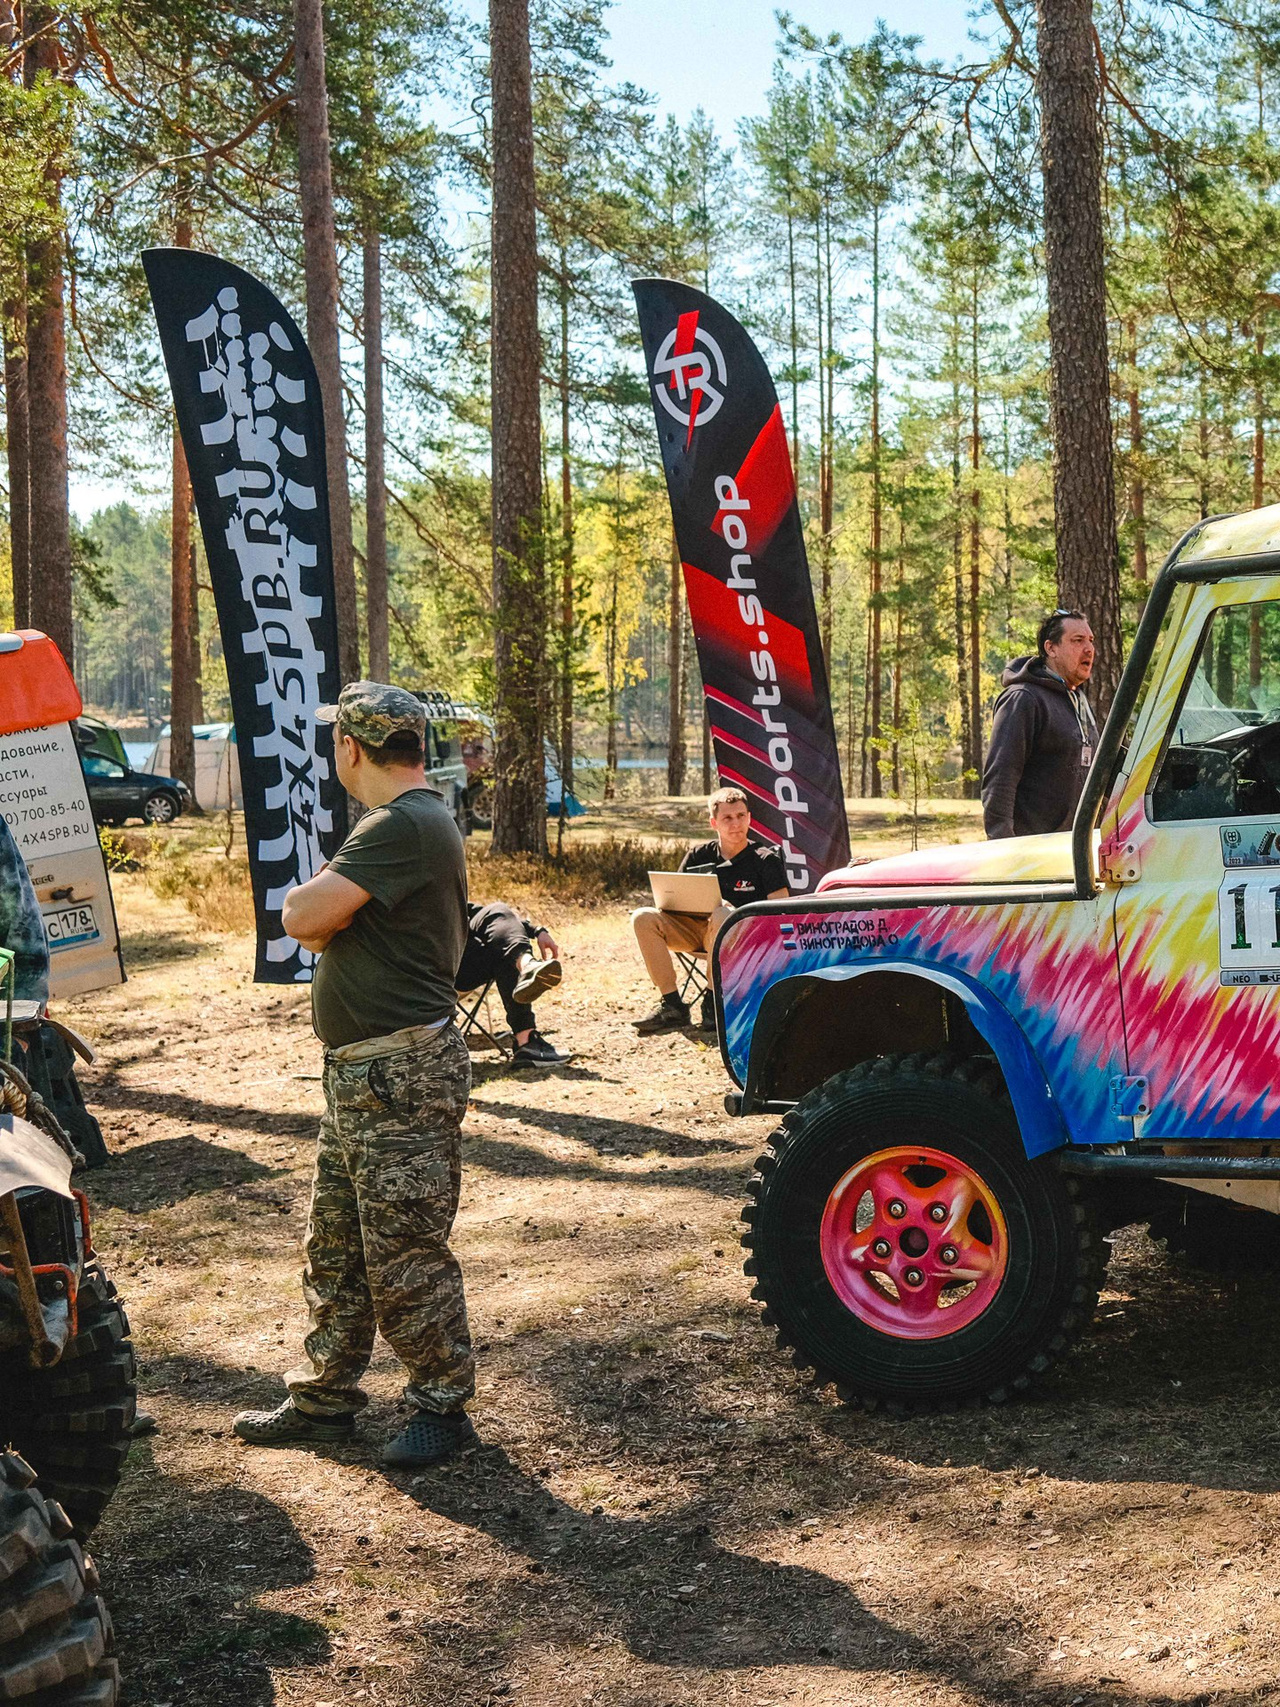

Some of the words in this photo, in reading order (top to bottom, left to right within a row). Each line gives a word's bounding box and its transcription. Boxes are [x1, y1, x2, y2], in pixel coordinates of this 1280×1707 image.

[236, 460, 315, 836] 4X4SPB.RU
[714, 475, 809, 889] cr-parts.shop
[1, 742, 64, 760] дование,
[0, 786, 48, 804] ссуары
[15, 823, 90, 847] .4X4SPB.RU
[61, 910, 92, 929] 178
[797, 920, 875, 935] ВИНОГРАДОВ
[800, 935, 885, 950] ВИНОГРАДОВА
[1232, 975, 1251, 984] NEO
